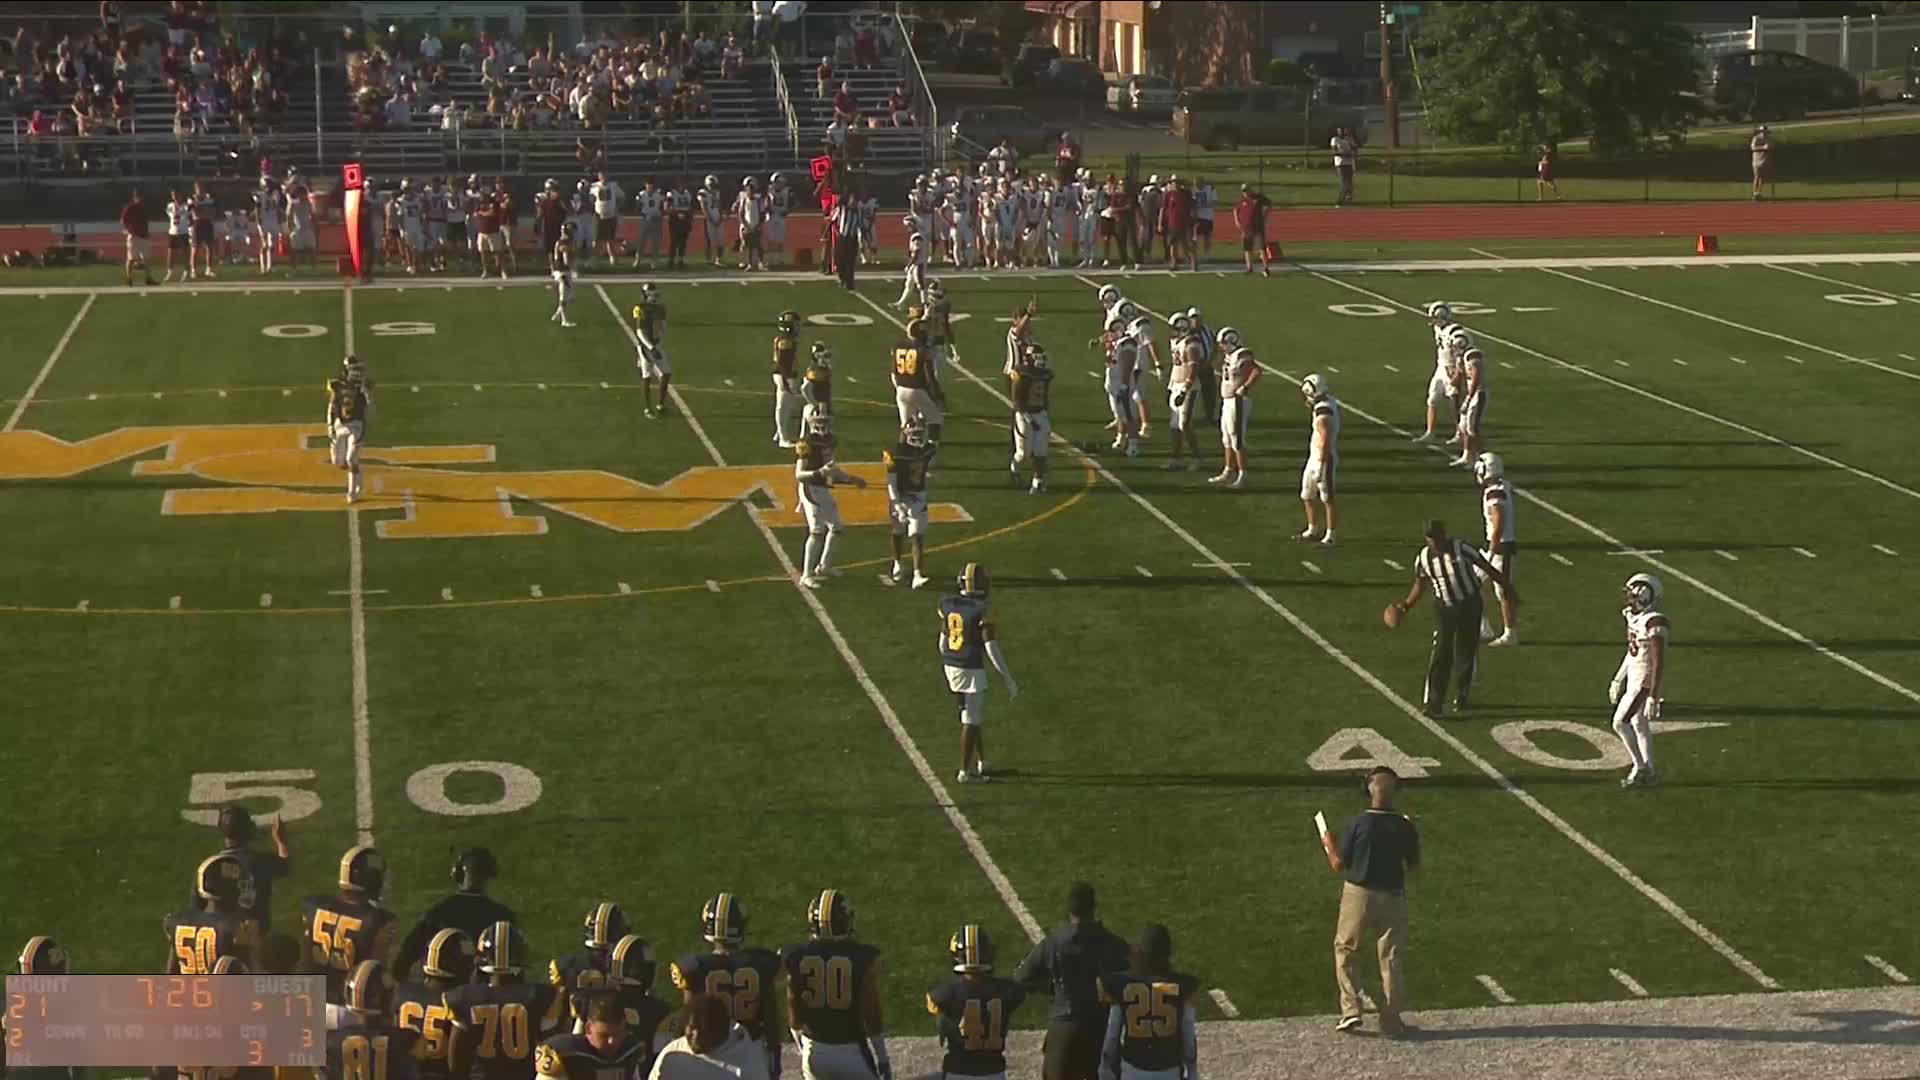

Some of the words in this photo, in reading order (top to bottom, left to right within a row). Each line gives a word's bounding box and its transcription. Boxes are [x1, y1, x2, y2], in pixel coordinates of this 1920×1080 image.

[947, 612, 964, 651] 8
[175, 925, 218, 974] 50
[312, 908, 363, 971] 55
[799, 955, 853, 1011] 30
[1122, 982, 1180, 1038] 25
[470, 1003, 530, 1060] 70
[959, 998, 1002, 1050] 41
